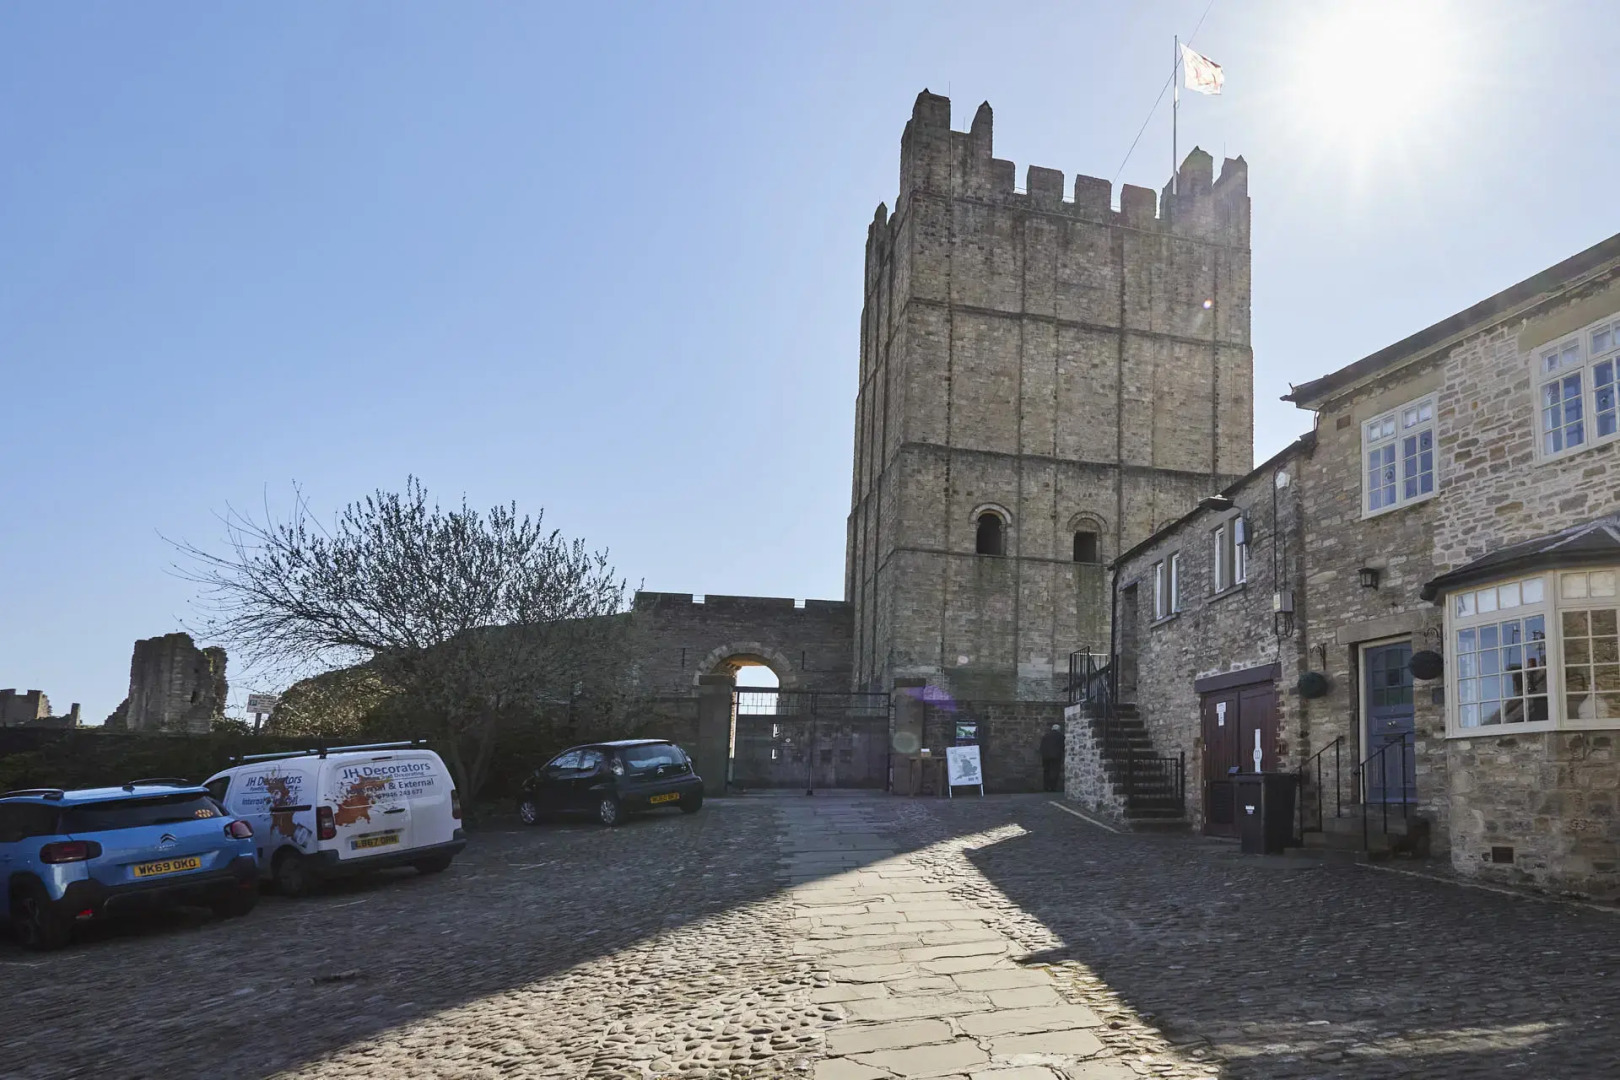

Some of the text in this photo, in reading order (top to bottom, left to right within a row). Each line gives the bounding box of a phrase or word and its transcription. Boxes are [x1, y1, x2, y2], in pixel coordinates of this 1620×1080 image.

[343, 768, 360, 779] JH
[363, 762, 431, 776] Decorators
[245, 777, 256, 787] JH
[398, 778, 434, 789] External
[138, 862, 171, 875] WK69
